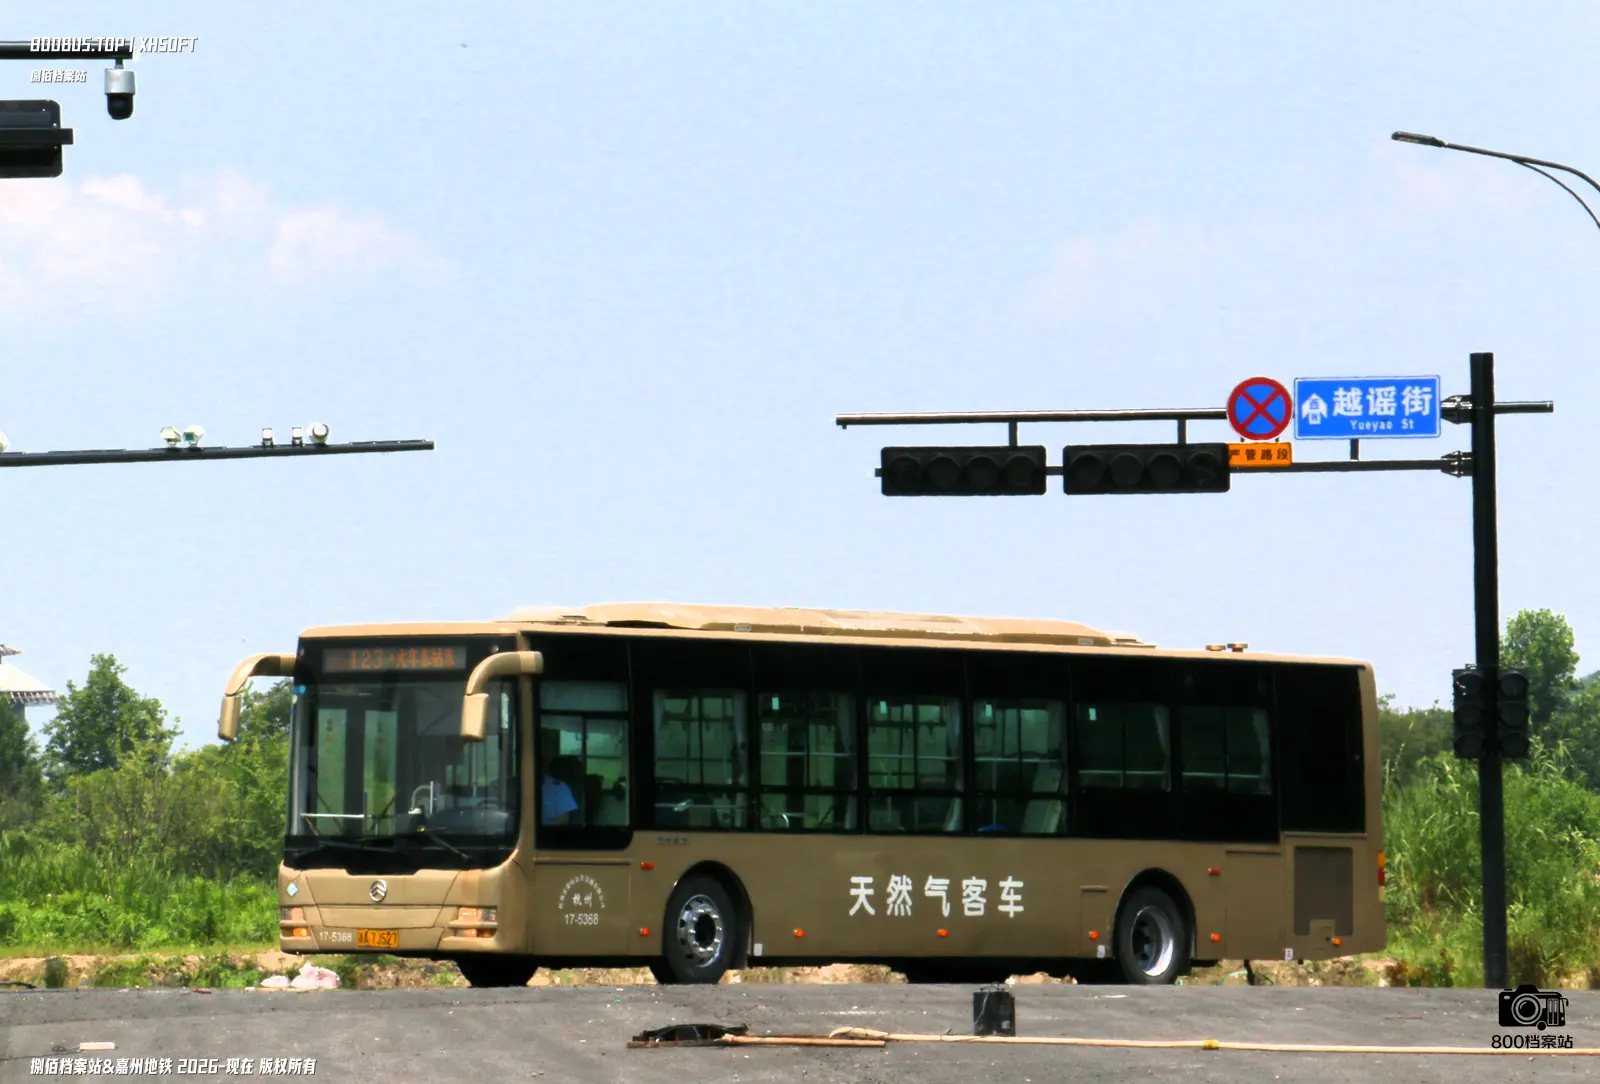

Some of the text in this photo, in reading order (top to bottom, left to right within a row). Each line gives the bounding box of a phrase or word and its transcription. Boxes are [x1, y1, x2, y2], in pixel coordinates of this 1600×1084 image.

[1332, 386, 1432, 417] 越谣街
[1350, 418, 1414, 432] Yueyao St
[848, 874, 1025, 918] 天然气客车
[564, 913, 599, 925] 17-5368
[319, 931, 353, 942] 17-5368
